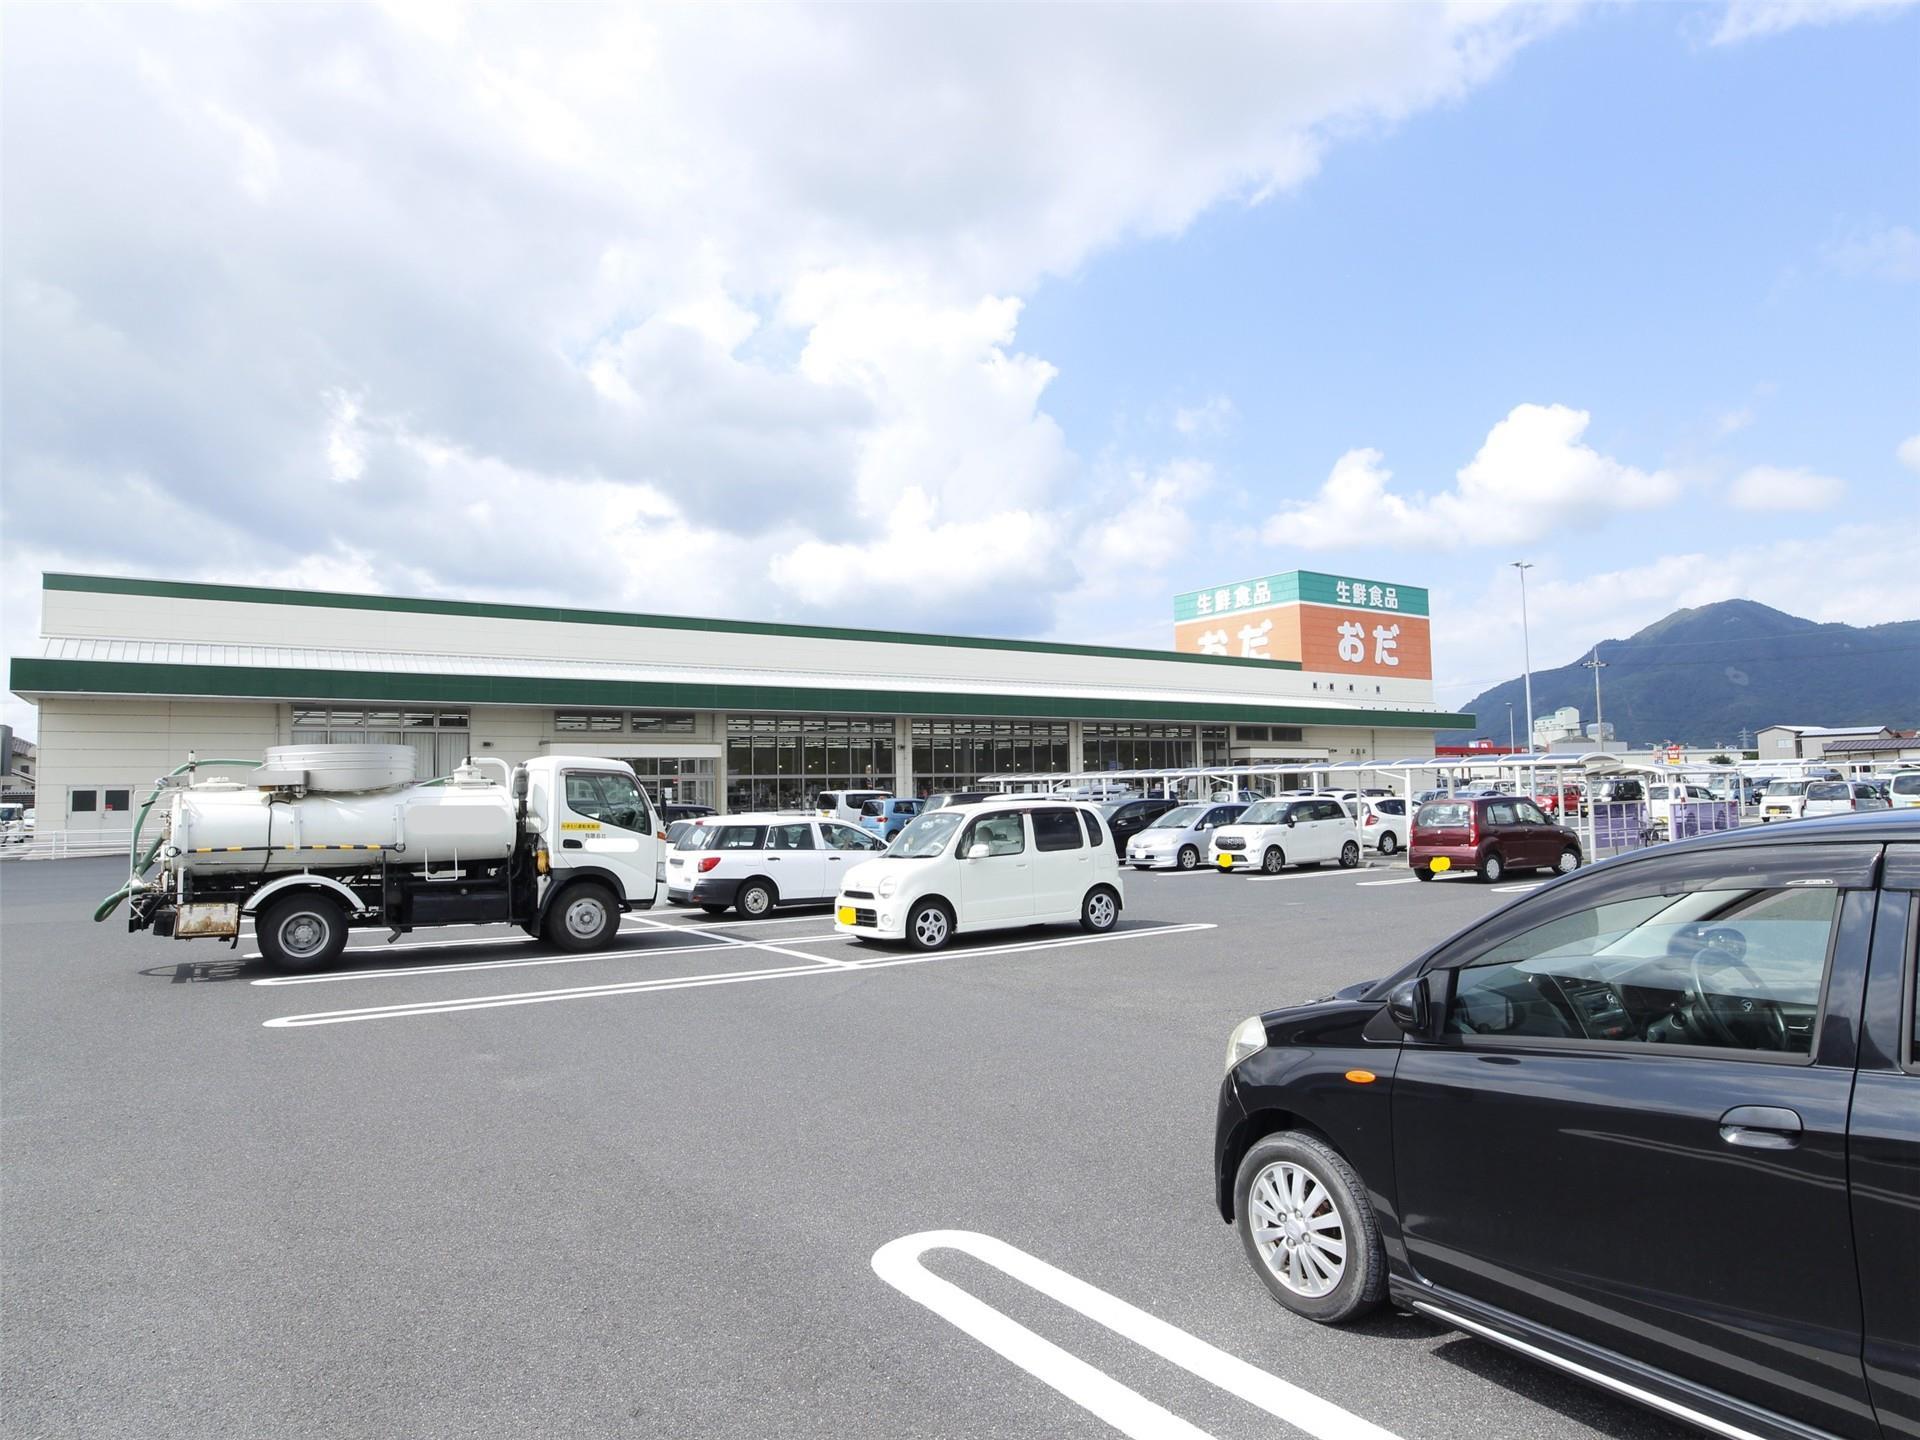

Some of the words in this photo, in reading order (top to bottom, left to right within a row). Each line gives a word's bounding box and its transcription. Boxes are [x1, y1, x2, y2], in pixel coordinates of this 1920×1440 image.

[1197, 581, 1271, 614] 生鮮食品
[1337, 581, 1398, 608] 生鮮食品
[1338, 621, 1399, 665] おだ
